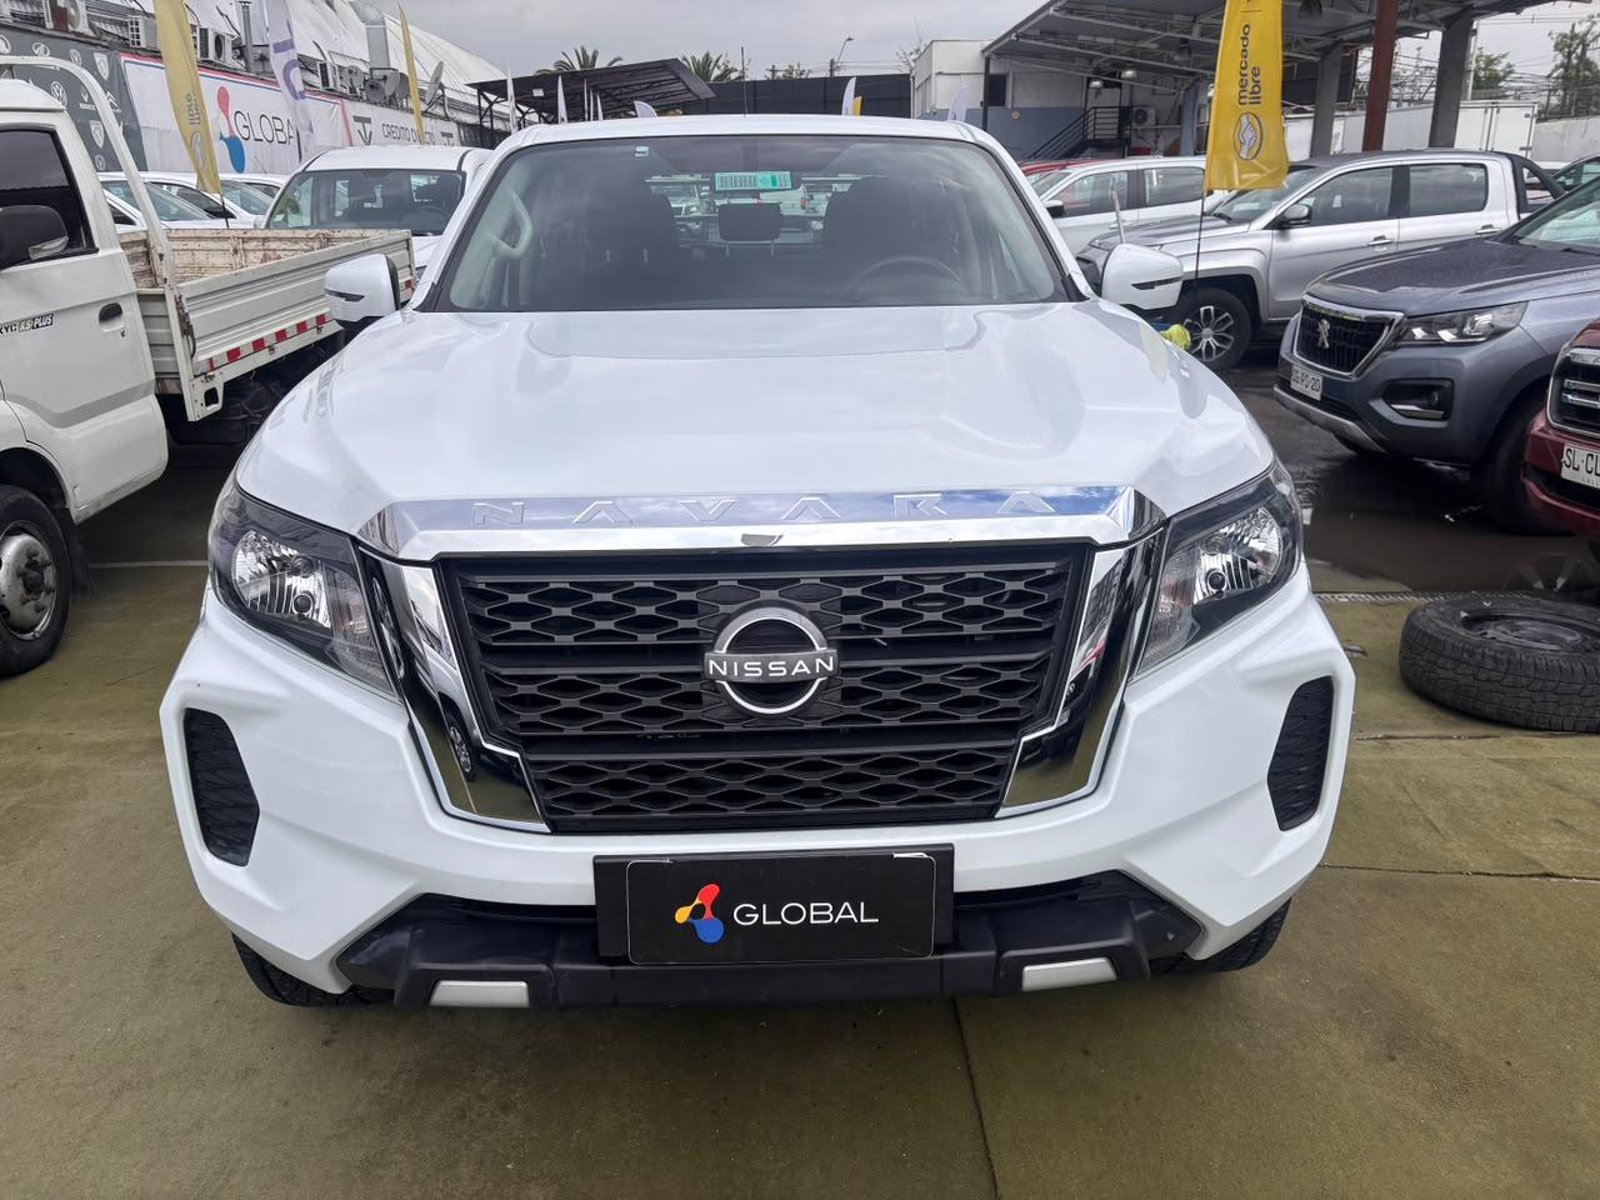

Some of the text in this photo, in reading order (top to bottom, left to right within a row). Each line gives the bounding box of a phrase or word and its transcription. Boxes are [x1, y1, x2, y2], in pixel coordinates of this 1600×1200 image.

[1238, 24, 1251, 106] mercado
[1249, 66, 1261, 105] libre
[234, 110, 294, 145] GLOBA
[472, 489, 1056, 526] NAVARA
[708, 656, 834, 677] NISSAN
[733, 901, 879, 926] GLOBAL
